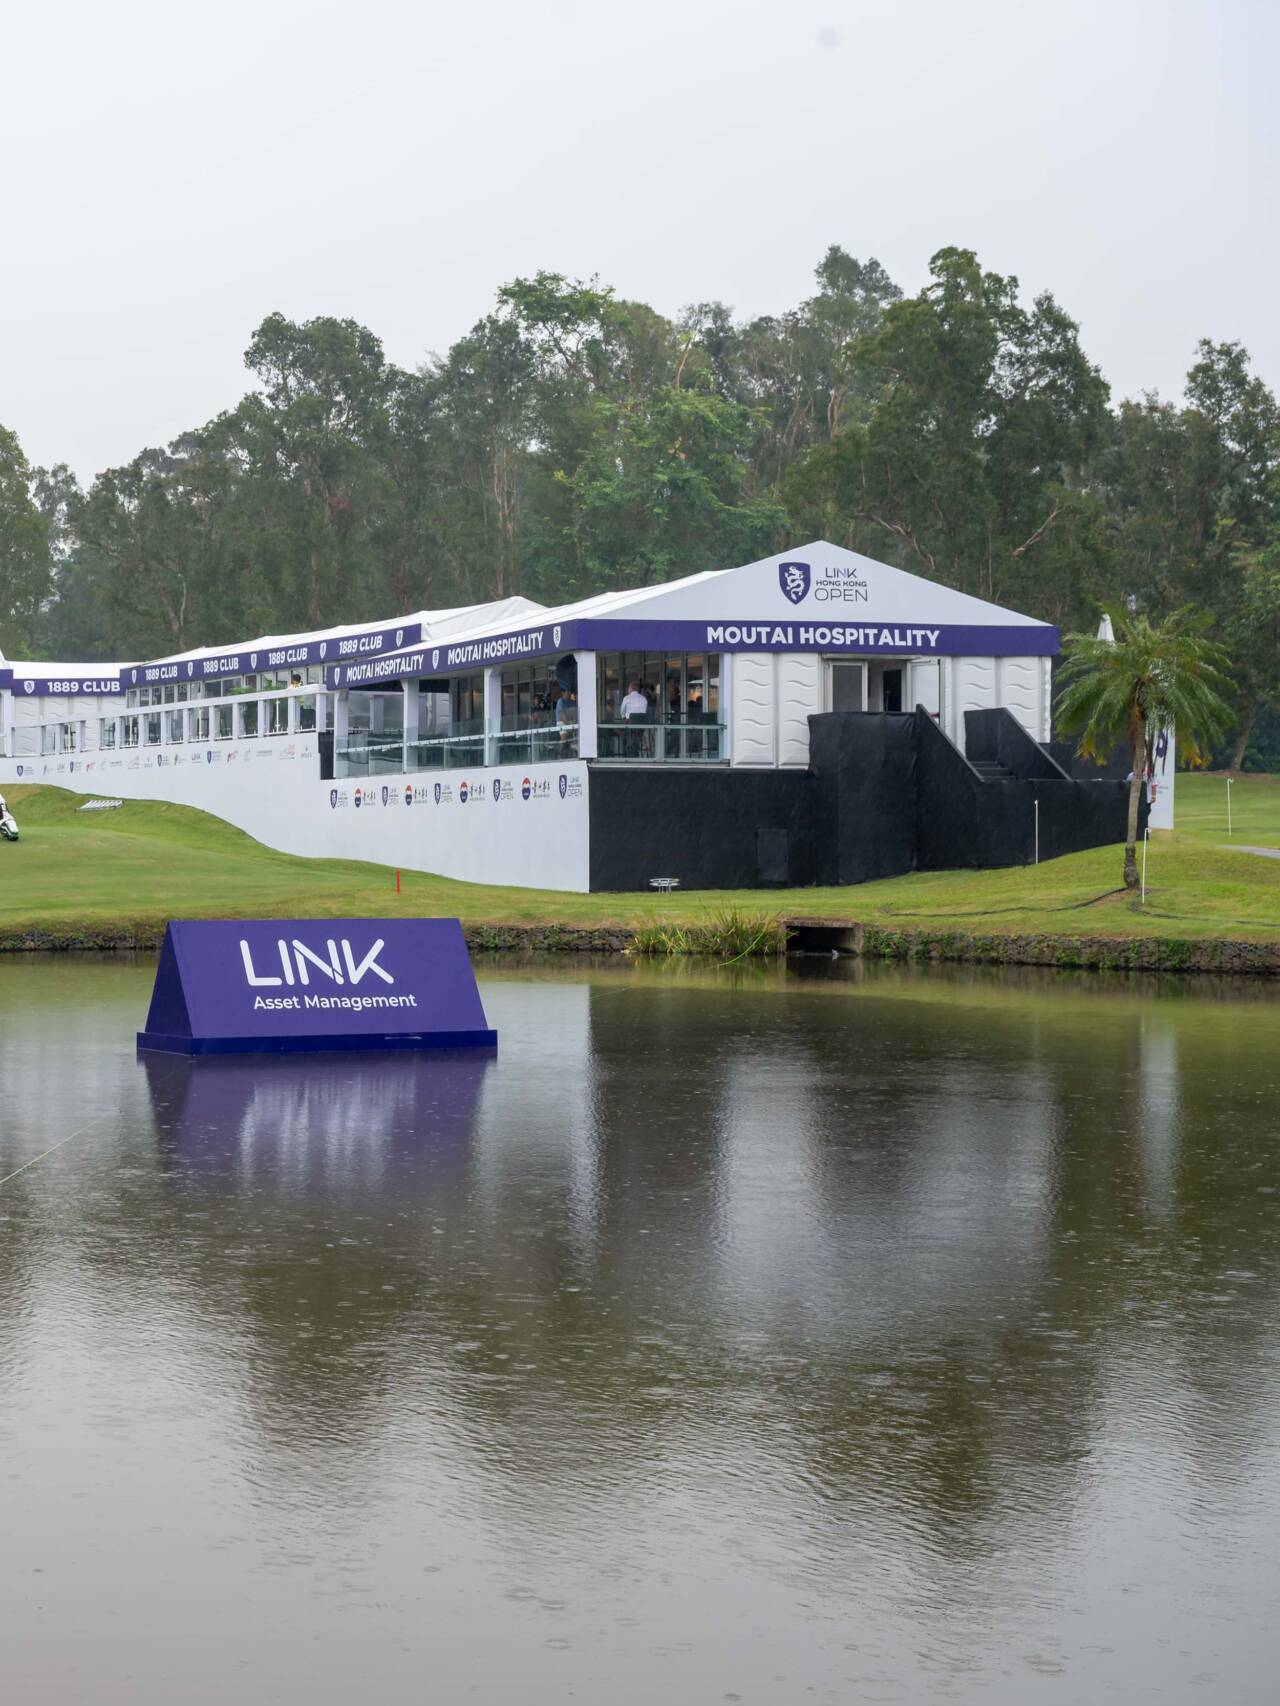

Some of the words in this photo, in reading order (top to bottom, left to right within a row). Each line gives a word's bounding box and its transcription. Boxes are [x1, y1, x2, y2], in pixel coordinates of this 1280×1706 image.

[825, 567, 857, 579] LINK
[843, 580, 867, 588] KONG
[814, 588, 868, 602] OPEN
[339, 639, 358, 654] 1889
[359, 635, 383, 651] CLUB
[707, 627, 792, 643] MOUTAI
[800, 628, 939, 646] HOSPITALITY
[269, 651, 286, 664] 1889
[287, 648, 308, 661] CLUB
[447, 646, 481, 665] MOUTAI
[483, 632, 543, 658] HOSPITALITY
[145, 668, 159, 680] 1889
[160, 666, 178, 679] CLUB
[204, 659, 219, 673] 1889
[220, 657, 239, 670] CLUB
[347, 663, 373, 682] MOUTAI
[374, 654, 424, 678] HOSPITALITY
[48, 682, 79, 692] 1889
[83, 681, 120, 692] CLUB
[240, 939, 394, 986] LINK
[253, 995, 301, 1010] Asset
[304, 994, 417, 1011] Management
